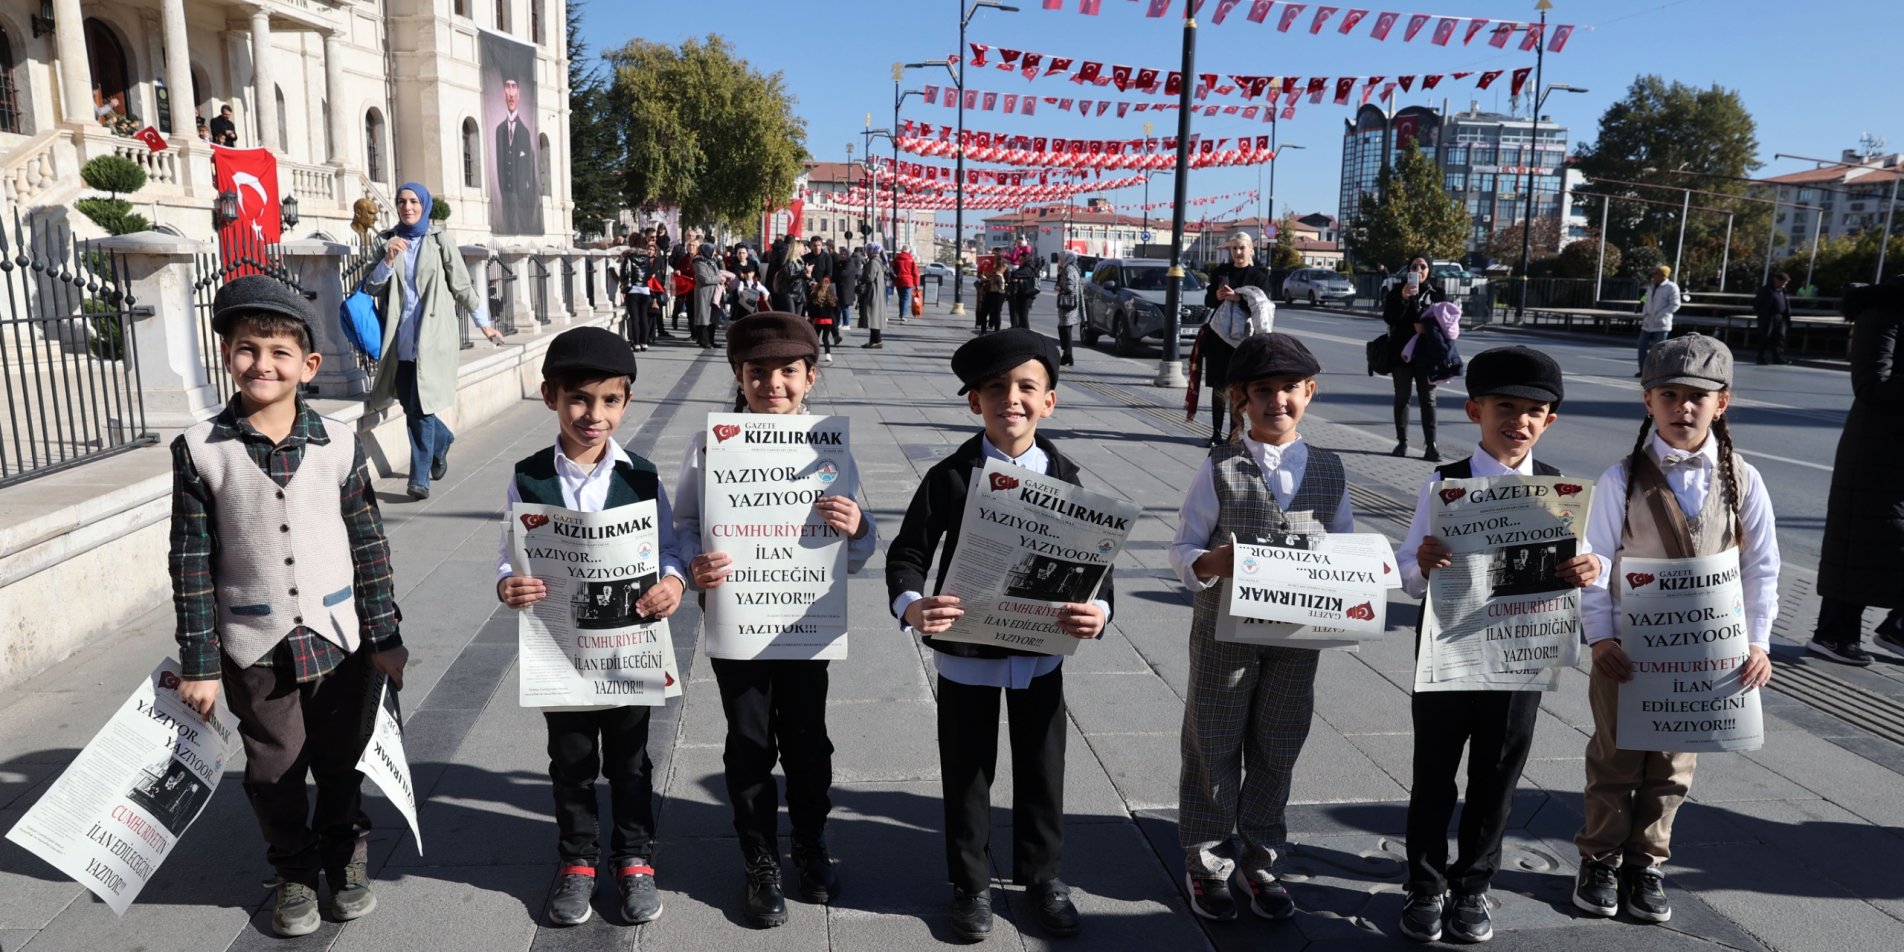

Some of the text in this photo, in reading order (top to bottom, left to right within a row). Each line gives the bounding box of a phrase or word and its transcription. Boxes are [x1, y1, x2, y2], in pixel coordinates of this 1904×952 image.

[744, 422, 777, 430] GAZETE
[744, 430, 842, 445] KIZILIRMAK
[713, 467, 810, 484] YAZIYOR...
[1024, 479, 1061, 496] GAZETE
[1469, 485, 1548, 504] GAZETE
[1019, 487, 1129, 531] KIZILIRMAK
[553, 513, 584, 526] GAZETE
[978, 507, 1060, 539] YAZIYOR...
[1441, 516, 1521, 537] YAZIYOR...
[553, 516, 652, 540] KIZILIRMAK
[524, 548, 602, 563] YAZIYOR...
[755, 543, 793, 559] İLAN
[725, 567, 826, 583] EDİLECEĞİNİ
[1659, 569, 1694, 578] GAZETE
[735, 592, 816, 605] YAZIYOR!!!
[1238, 585, 1343, 612] KIZILIRMAK
[983, 614, 1008, 628] İLAN
[1309, 609, 1341, 620] GAZETE
[1628, 607, 1728, 627] YAZIYOR...
[1485, 617, 1577, 641] İLAN EDİLDİĞİNİ
[994, 633, 1044, 647] YAZIYOR!!!
[574, 651, 662, 671] İLAN EDİLECEĞİNİ
[1503, 645, 1558, 663] YAZIYOR!!!
[594, 680, 644, 695] YAZIYOR!!!
[1672, 678, 1713, 693] İLAN
[1642, 693, 1745, 713] EDİLECEĞİNİ
[1652, 719, 1736, 733] YAZIYOR!!!
[86, 821, 115, 848] İLAN
